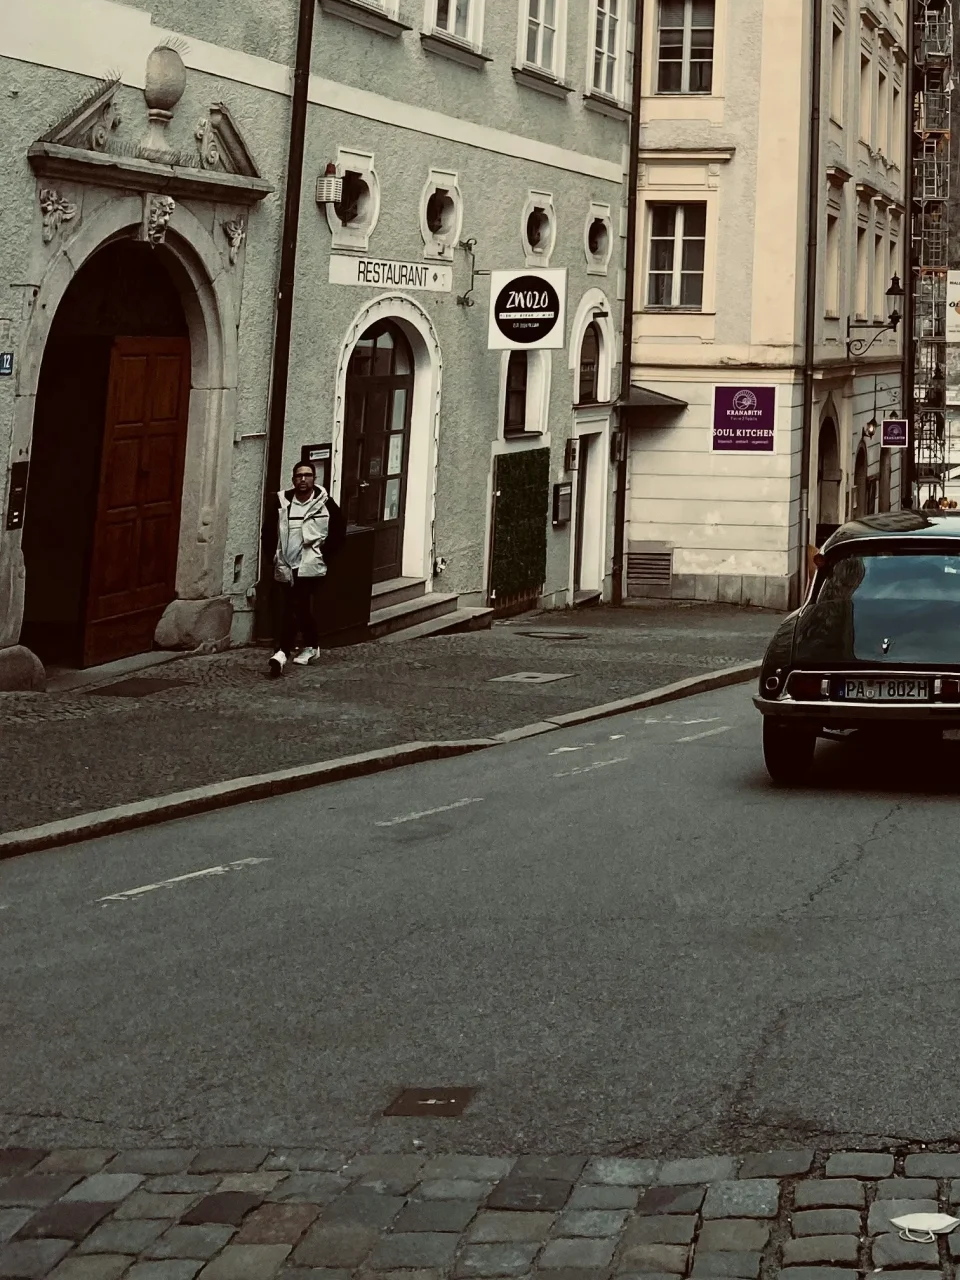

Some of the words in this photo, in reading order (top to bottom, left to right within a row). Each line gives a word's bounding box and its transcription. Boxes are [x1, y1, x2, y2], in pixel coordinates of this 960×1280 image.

[357, 260, 429, 287] RESTAURANT
[3, 354, 11, 368] 12
[713, 428, 735, 437] SOUL
[736, 429, 774, 437] KITCHEN
[846, 681, 865, 698] PA
